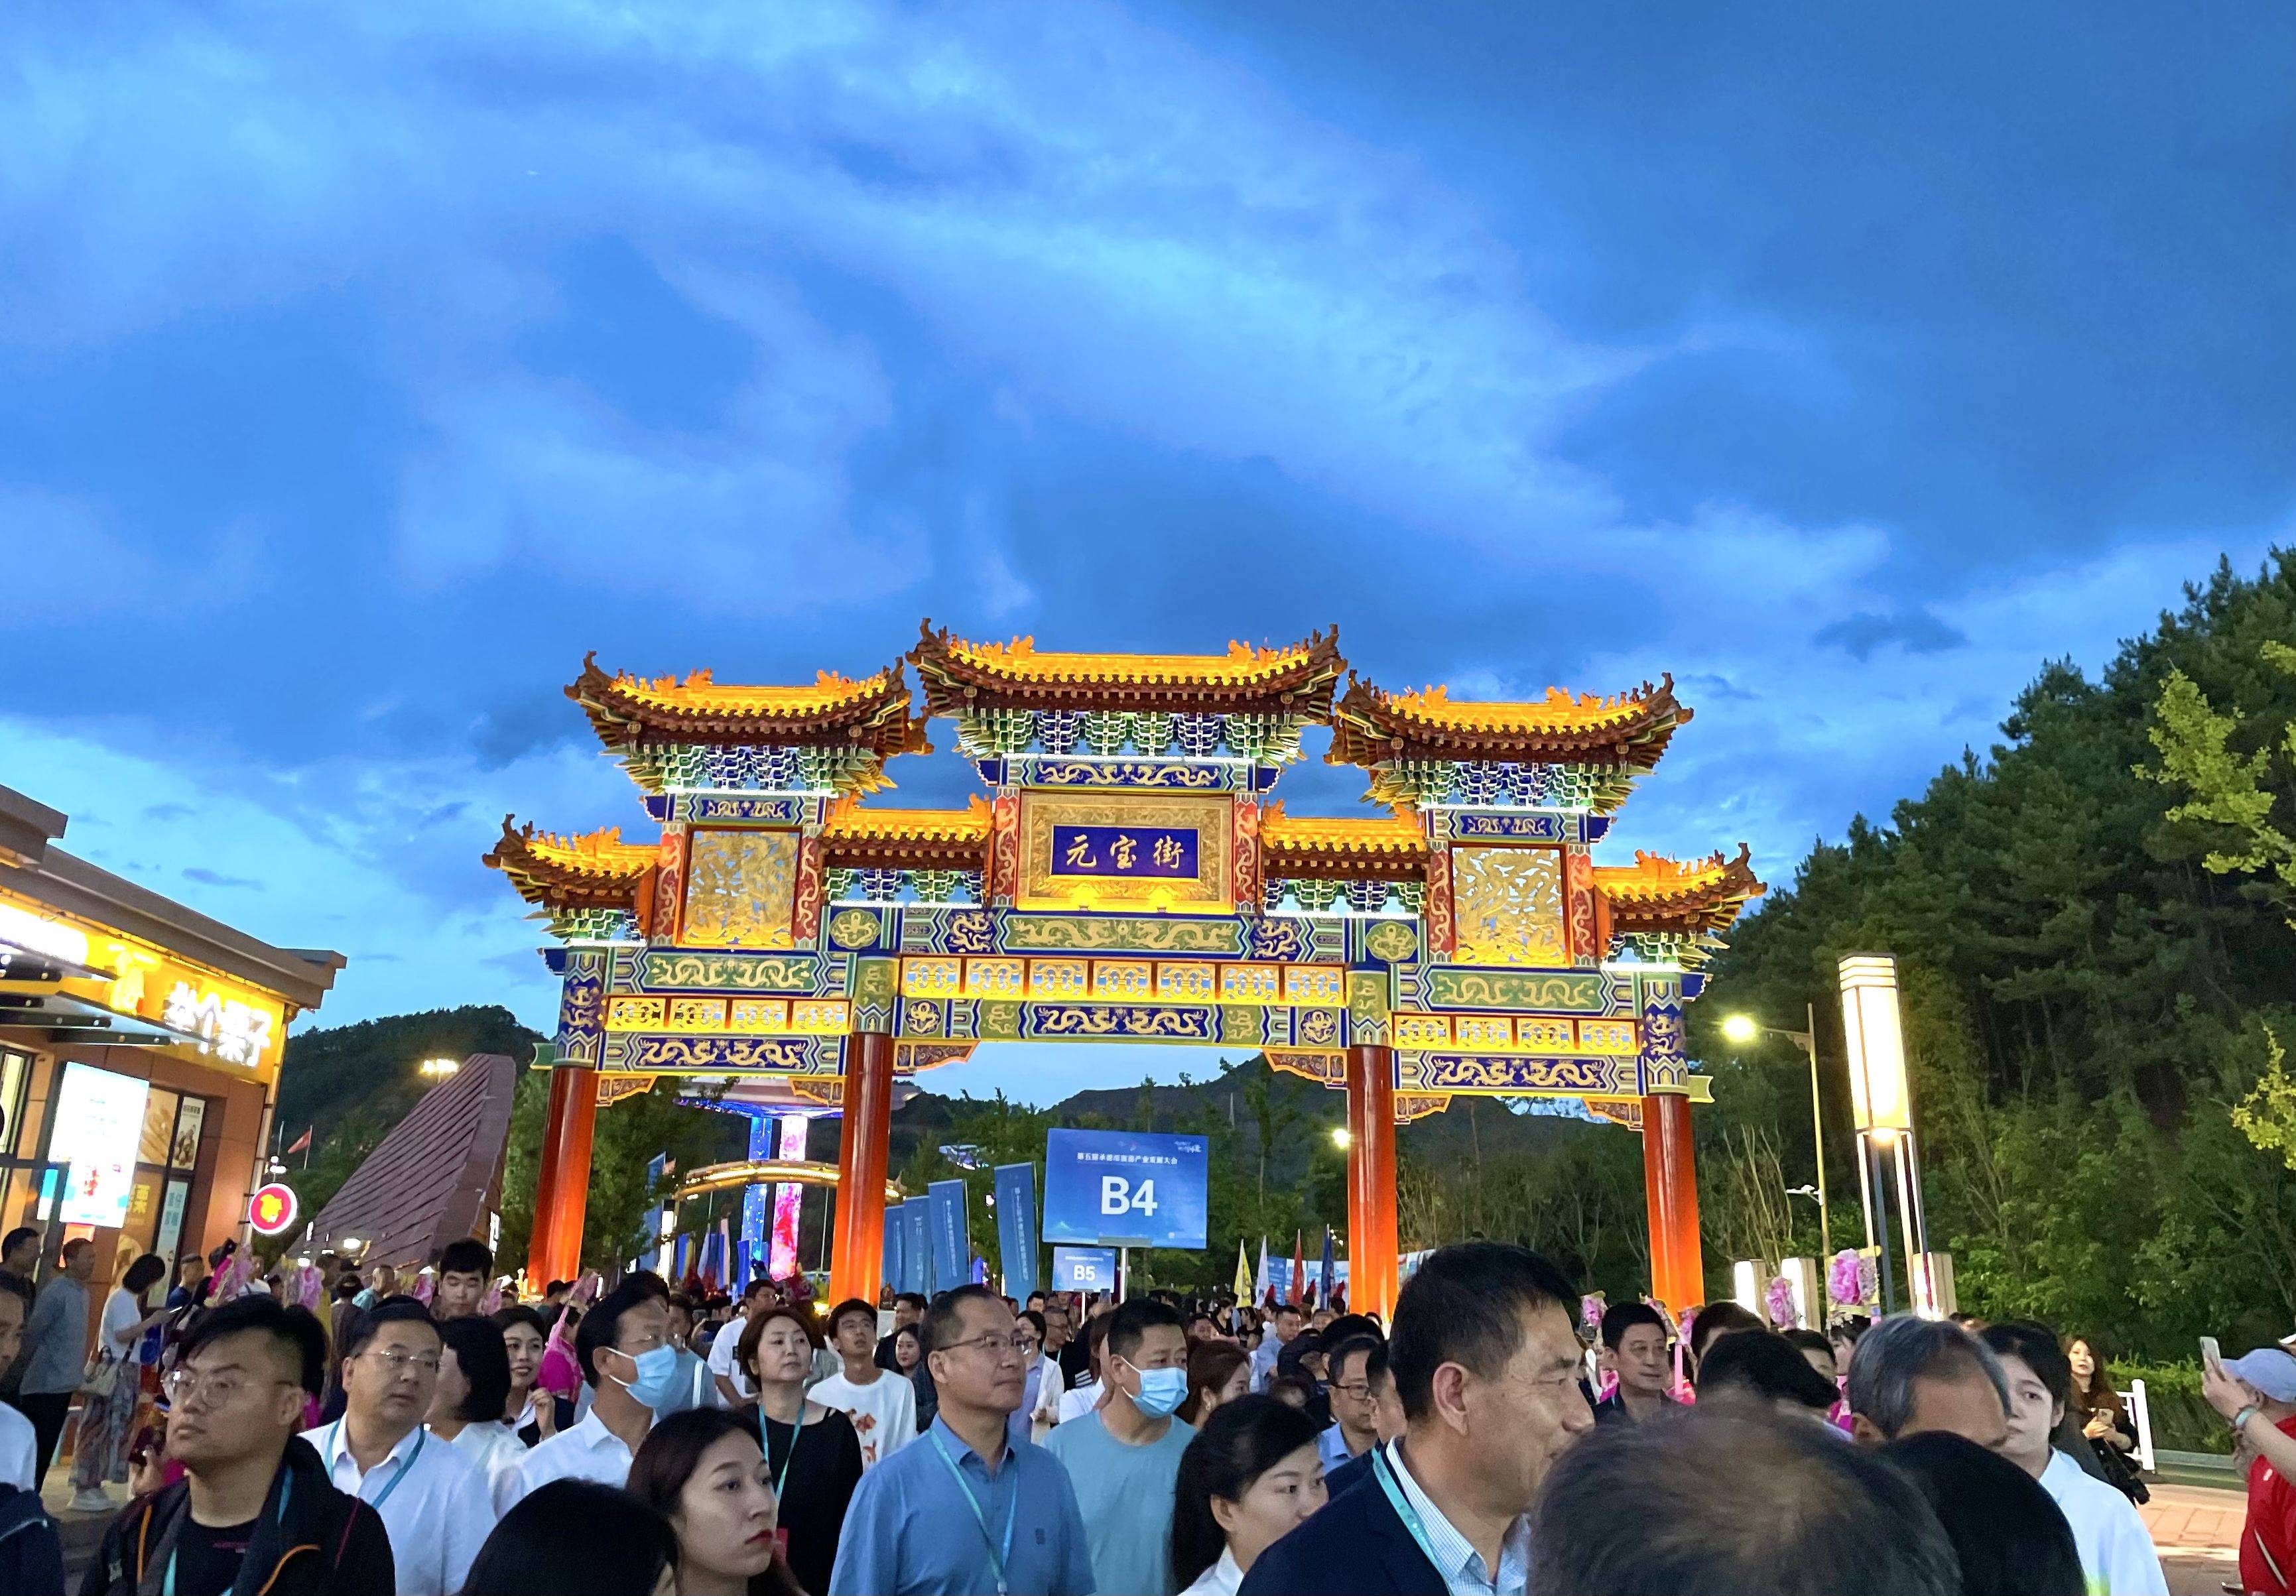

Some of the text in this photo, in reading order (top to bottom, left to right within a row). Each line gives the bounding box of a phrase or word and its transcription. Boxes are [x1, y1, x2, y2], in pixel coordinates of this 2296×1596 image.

[1066, 833, 1184, 869] 元宝街
[1102, 1176, 1158, 1216] B4
[1074, 1264, 1096, 1281] B5
